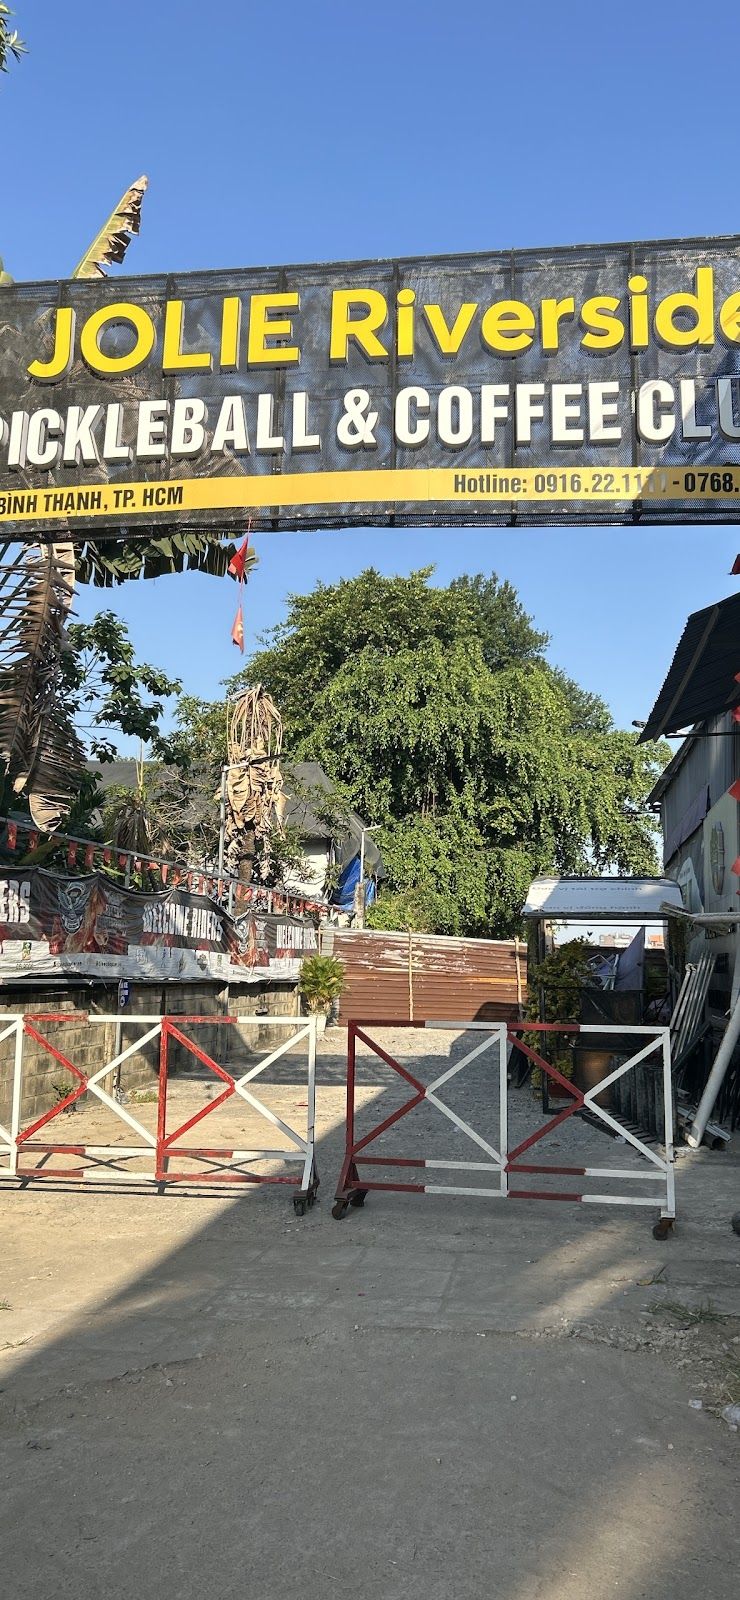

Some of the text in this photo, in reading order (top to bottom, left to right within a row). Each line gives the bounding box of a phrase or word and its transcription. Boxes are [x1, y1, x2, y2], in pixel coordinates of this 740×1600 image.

[27, 291, 300, 381] JOLIE
[0, 393, 322, 469] ICKLEBALL
[336, 388, 379, 448] &
[395, 381, 624, 446] COFFEE
[0, 486, 184, 515] BÌNH THẠNH, TP. HCM
[454, 473, 527, 493] Hotline:
